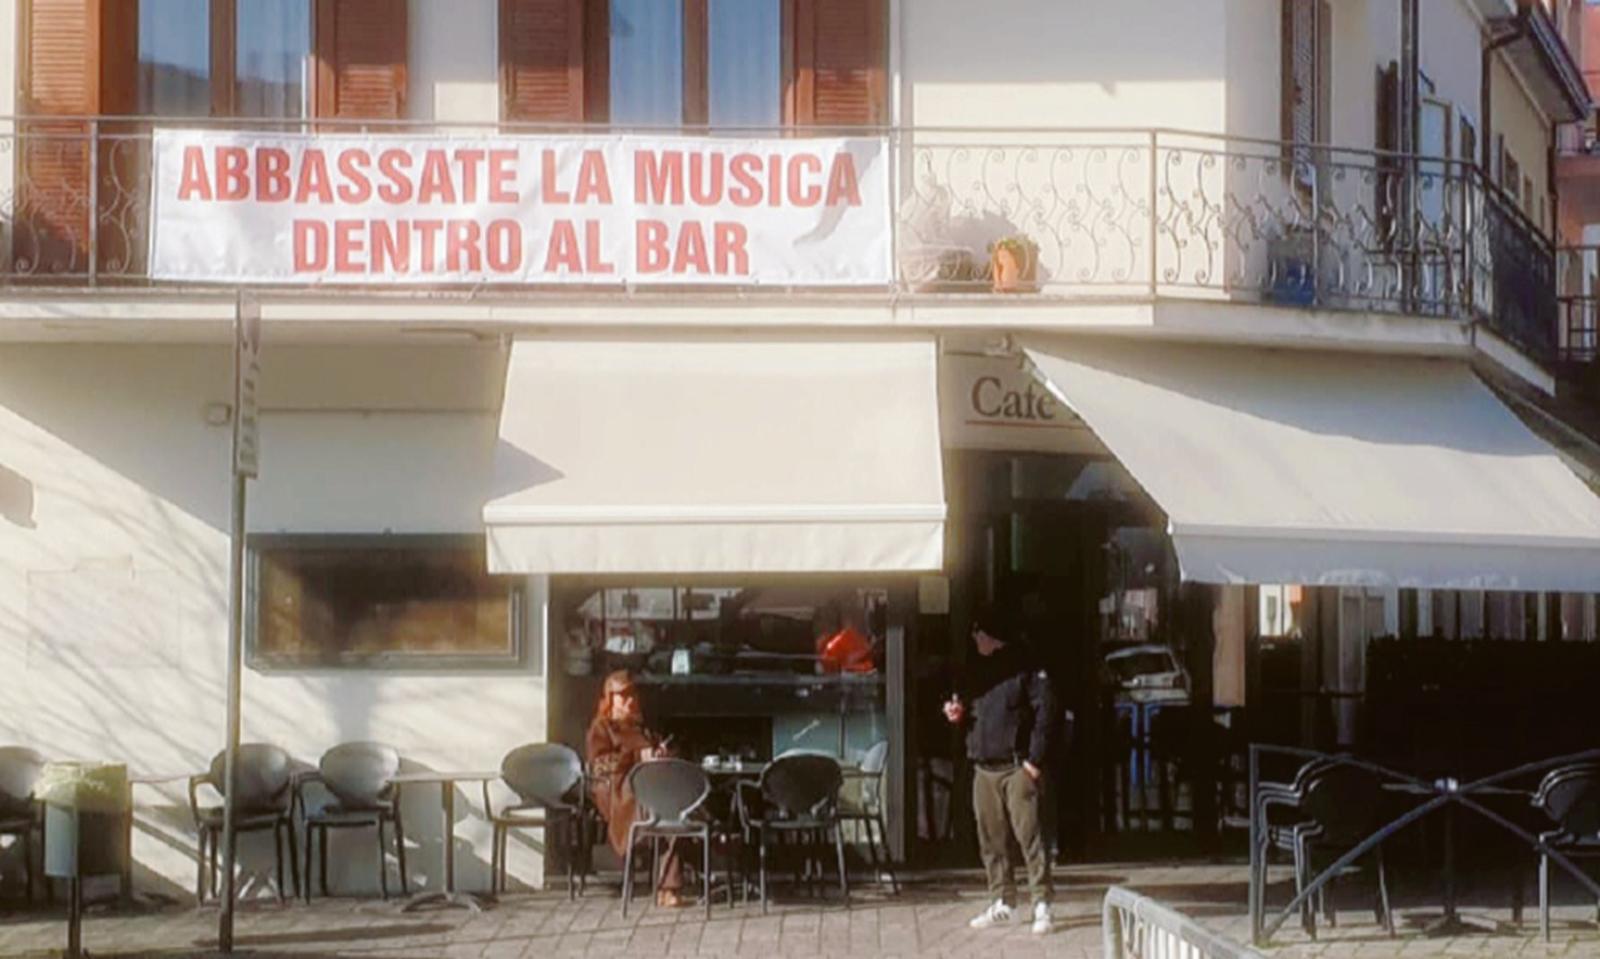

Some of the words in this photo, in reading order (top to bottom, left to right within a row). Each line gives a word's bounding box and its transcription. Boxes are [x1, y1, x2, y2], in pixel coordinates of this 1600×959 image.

[179, 147, 518, 204] ABBASSATE
[542, 151, 612, 204] LA
[633, 151, 861, 207] MUSICA
[293, 219, 523, 274] DENTRO
[546, 221, 613, 273] AL
[636, 220, 748, 275] BAR
